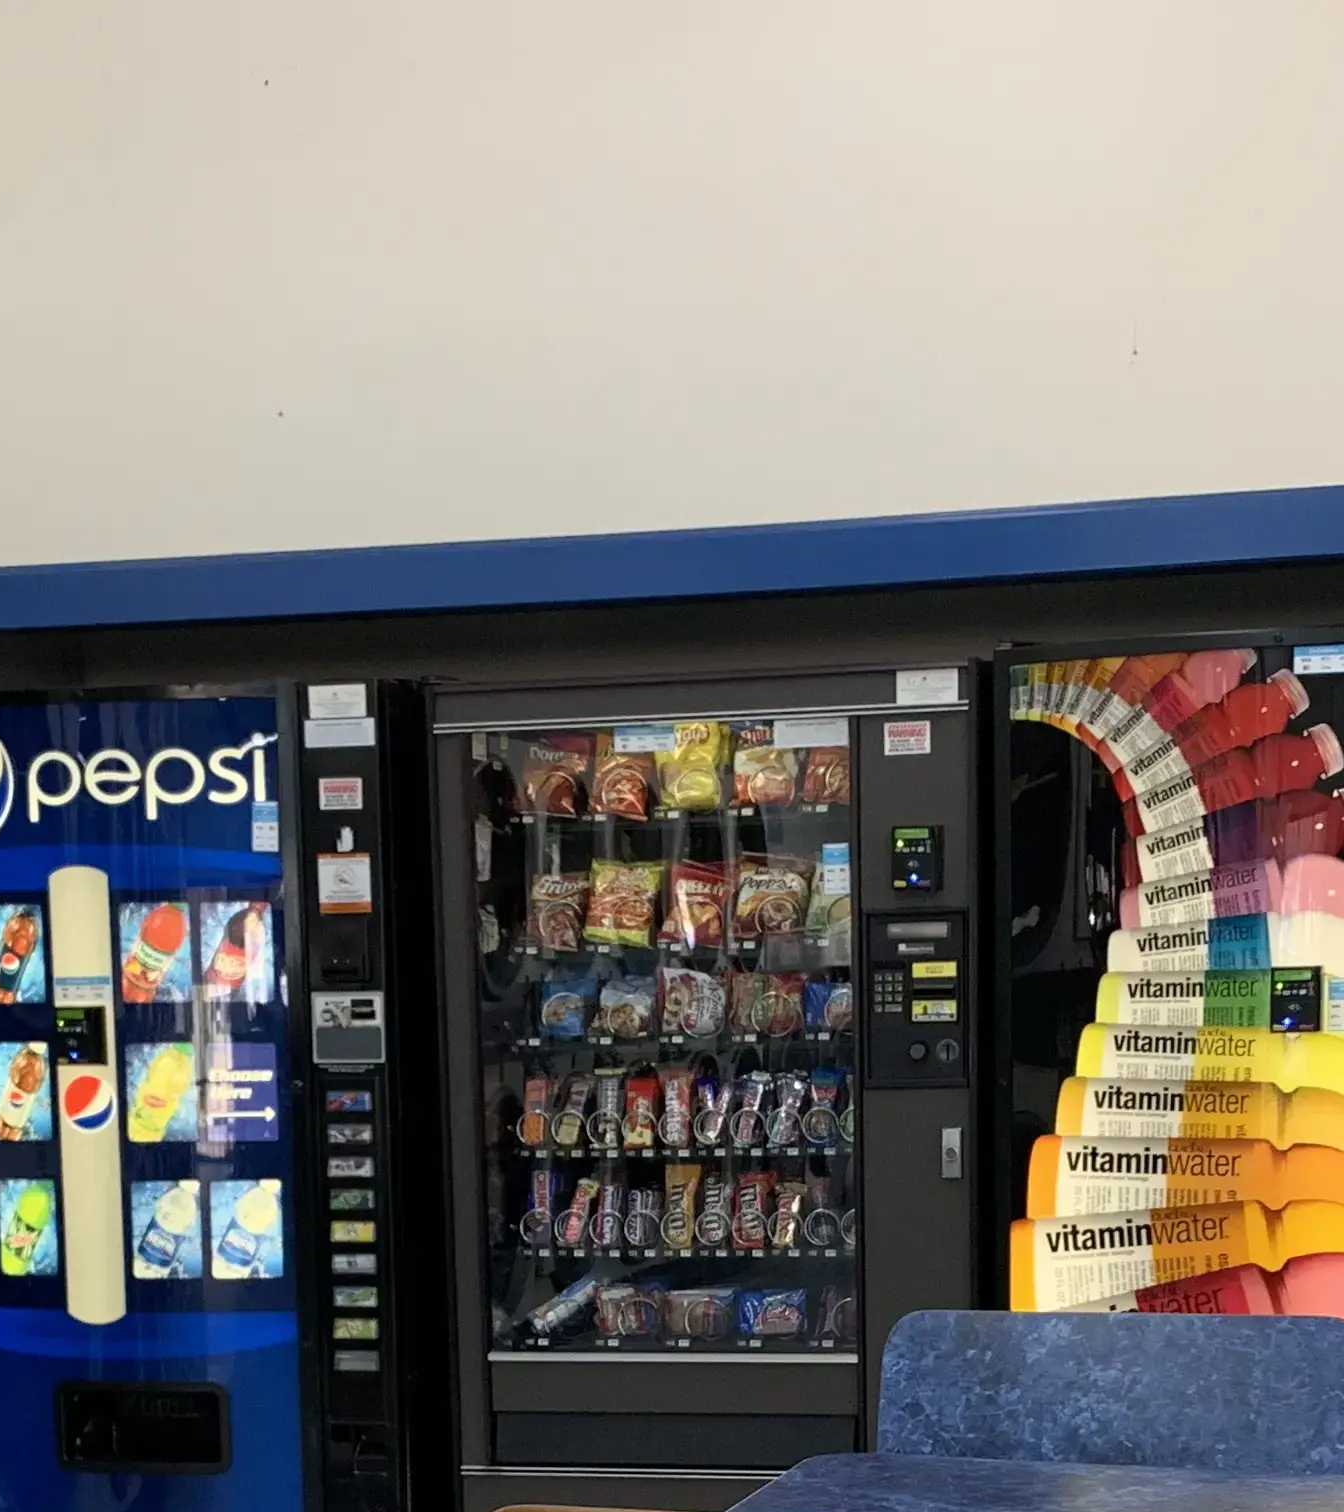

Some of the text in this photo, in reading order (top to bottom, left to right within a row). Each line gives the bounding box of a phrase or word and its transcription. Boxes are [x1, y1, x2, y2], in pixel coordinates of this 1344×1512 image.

[27, 733, 268, 823] pepsi
[1113, 1029, 1256, 1058] vitaminwater
[1093, 1084, 1249, 1115] vitaminwater
[1066, 1144, 1242, 1178] vitaminwater
[1045, 1213, 1231, 1254] vitaminwater
